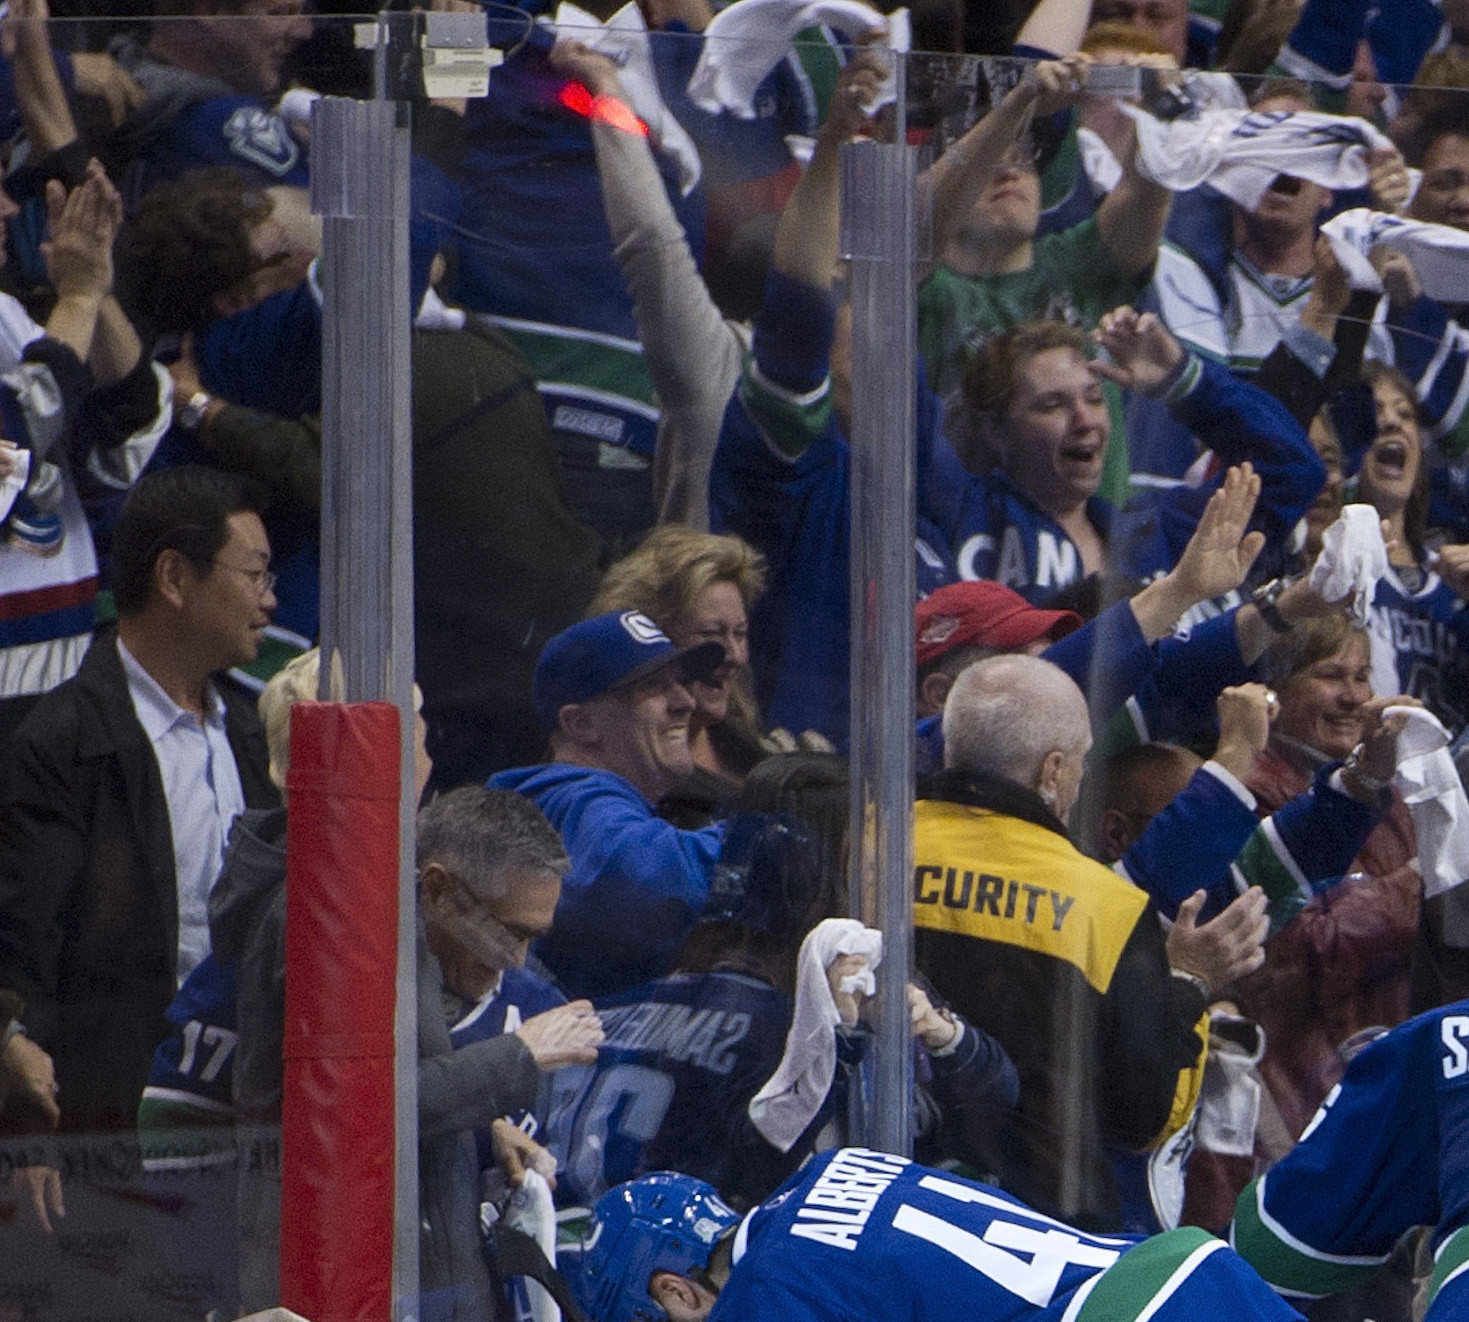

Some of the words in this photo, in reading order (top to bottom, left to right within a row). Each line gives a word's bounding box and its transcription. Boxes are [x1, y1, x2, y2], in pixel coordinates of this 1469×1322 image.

[914, 865, 1075, 931] CURITY
[177, 1018, 239, 1083] 17
[788, 1147, 913, 1251] ALBERTS
